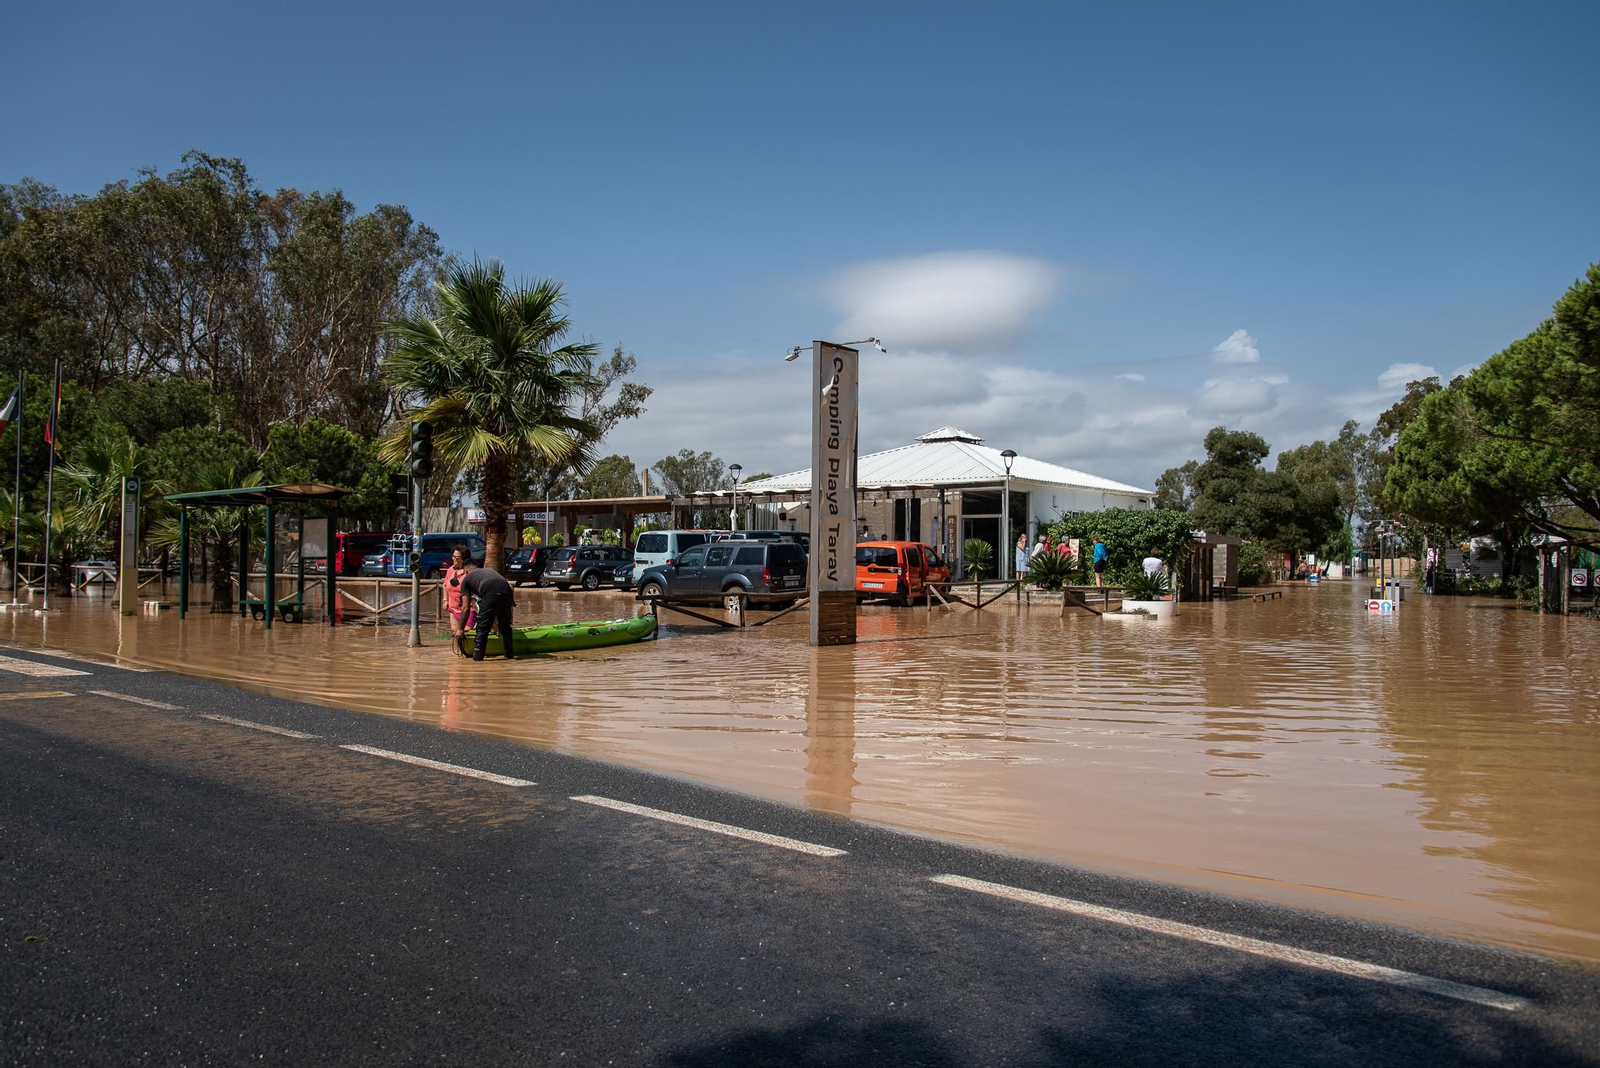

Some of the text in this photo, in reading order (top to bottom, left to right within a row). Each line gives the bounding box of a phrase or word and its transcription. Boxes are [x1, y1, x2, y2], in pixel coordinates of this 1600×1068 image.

[826, 357, 844, 582] Camping Playa Taray
